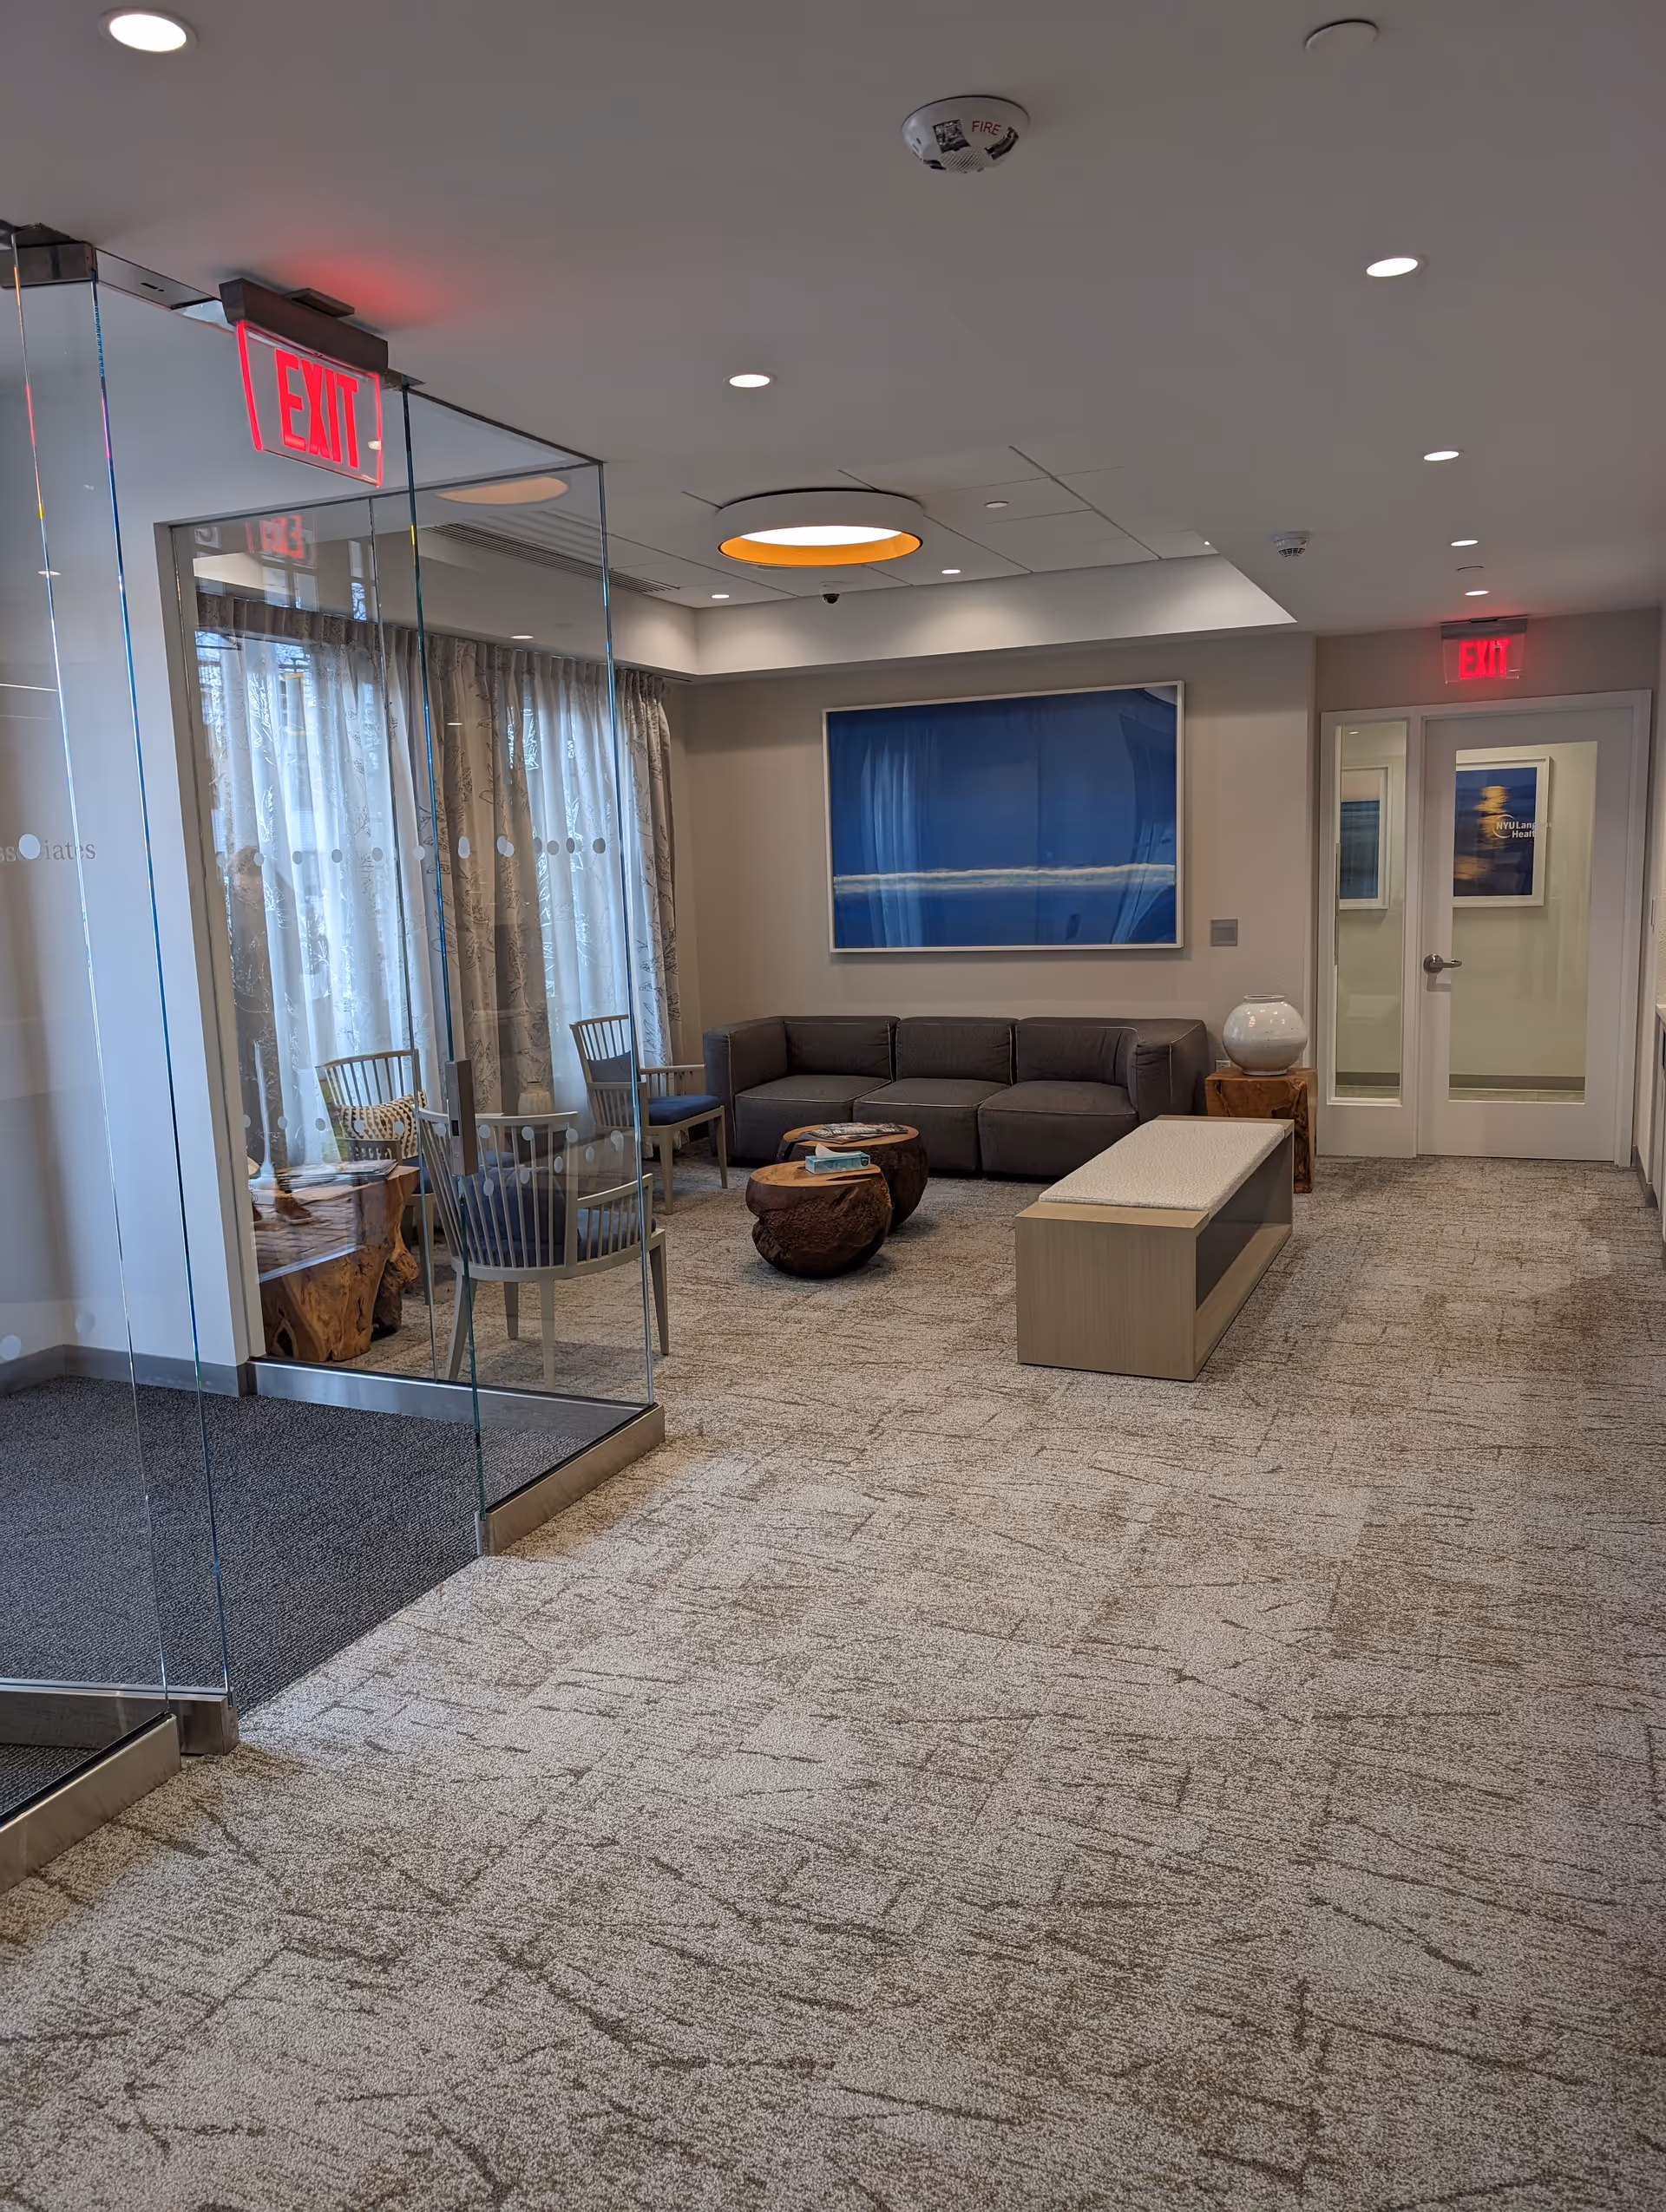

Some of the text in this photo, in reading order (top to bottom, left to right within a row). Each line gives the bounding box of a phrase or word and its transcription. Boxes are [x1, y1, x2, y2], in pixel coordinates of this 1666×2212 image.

[972, 121, 1001, 136] FIRE
[274, 349, 360, 469] EXIT
[1459, 637, 1511, 679] EXIT
[1496, 821, 1515, 830] NYU
[1512, 830, 1536, 839] Healt
